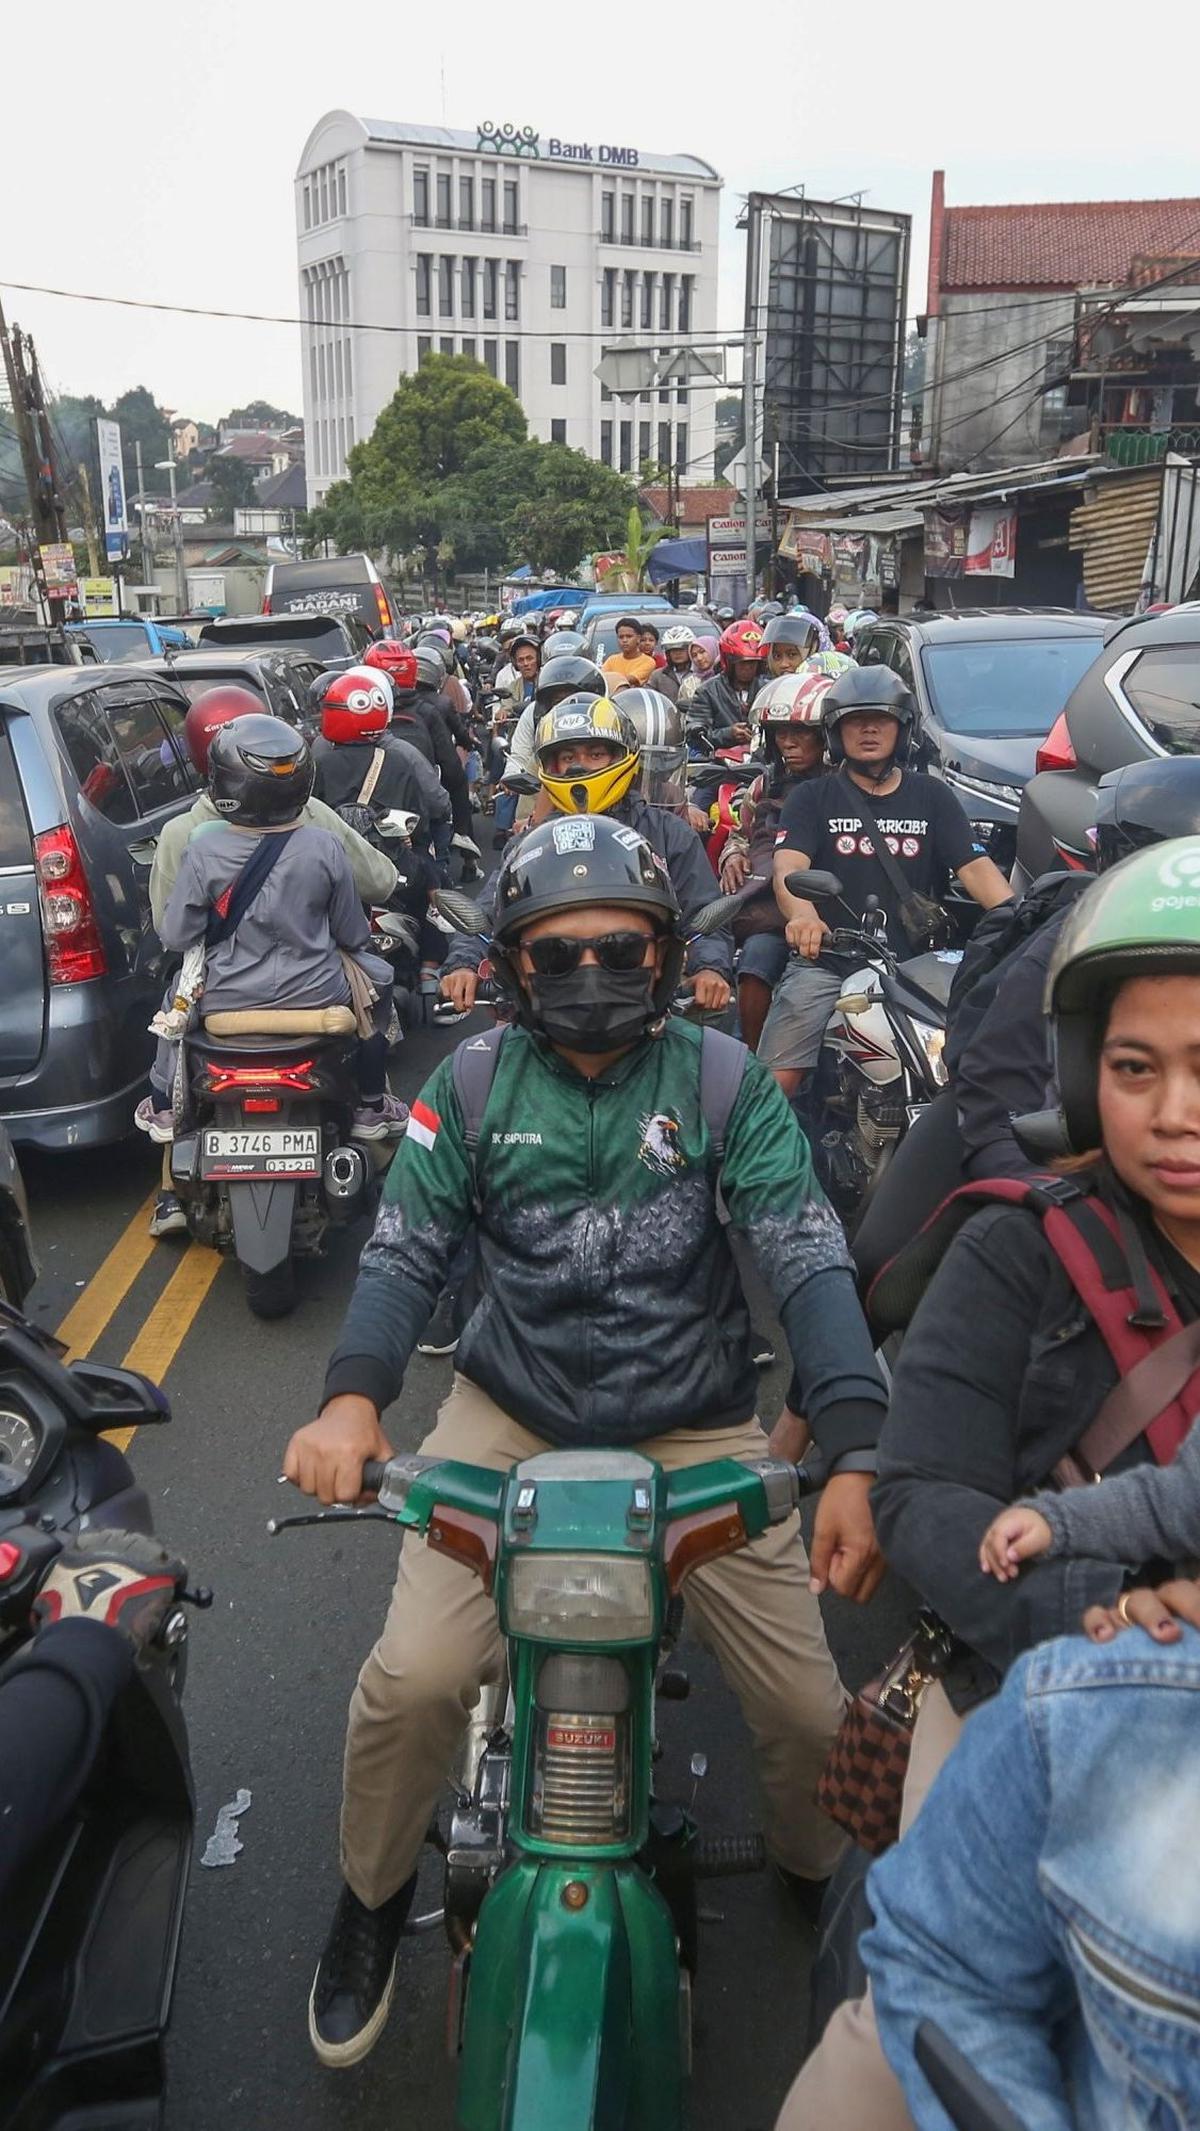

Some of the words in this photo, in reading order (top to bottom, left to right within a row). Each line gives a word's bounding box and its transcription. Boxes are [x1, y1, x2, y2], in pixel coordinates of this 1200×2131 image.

[549, 138, 593, 161] Bank
[599, 145, 639, 166] DMB
[712, 520, 745, 530] Canon
[713, 552, 746, 561] Canon
[290, 597, 357, 613] MADANI
[828, 818, 863, 833] STOP
[874, 818, 929, 835] ARKOBA
[1151, 896, 1200, 912] goje
[209, 1135, 219, 1153] B
[229, 1135, 272, 1153] 3746
[282, 1134, 315, 1152] PMA
[504, 1132, 542, 1145] SAPUTRA
[555, 1732, 609, 1744] SUZUKI
